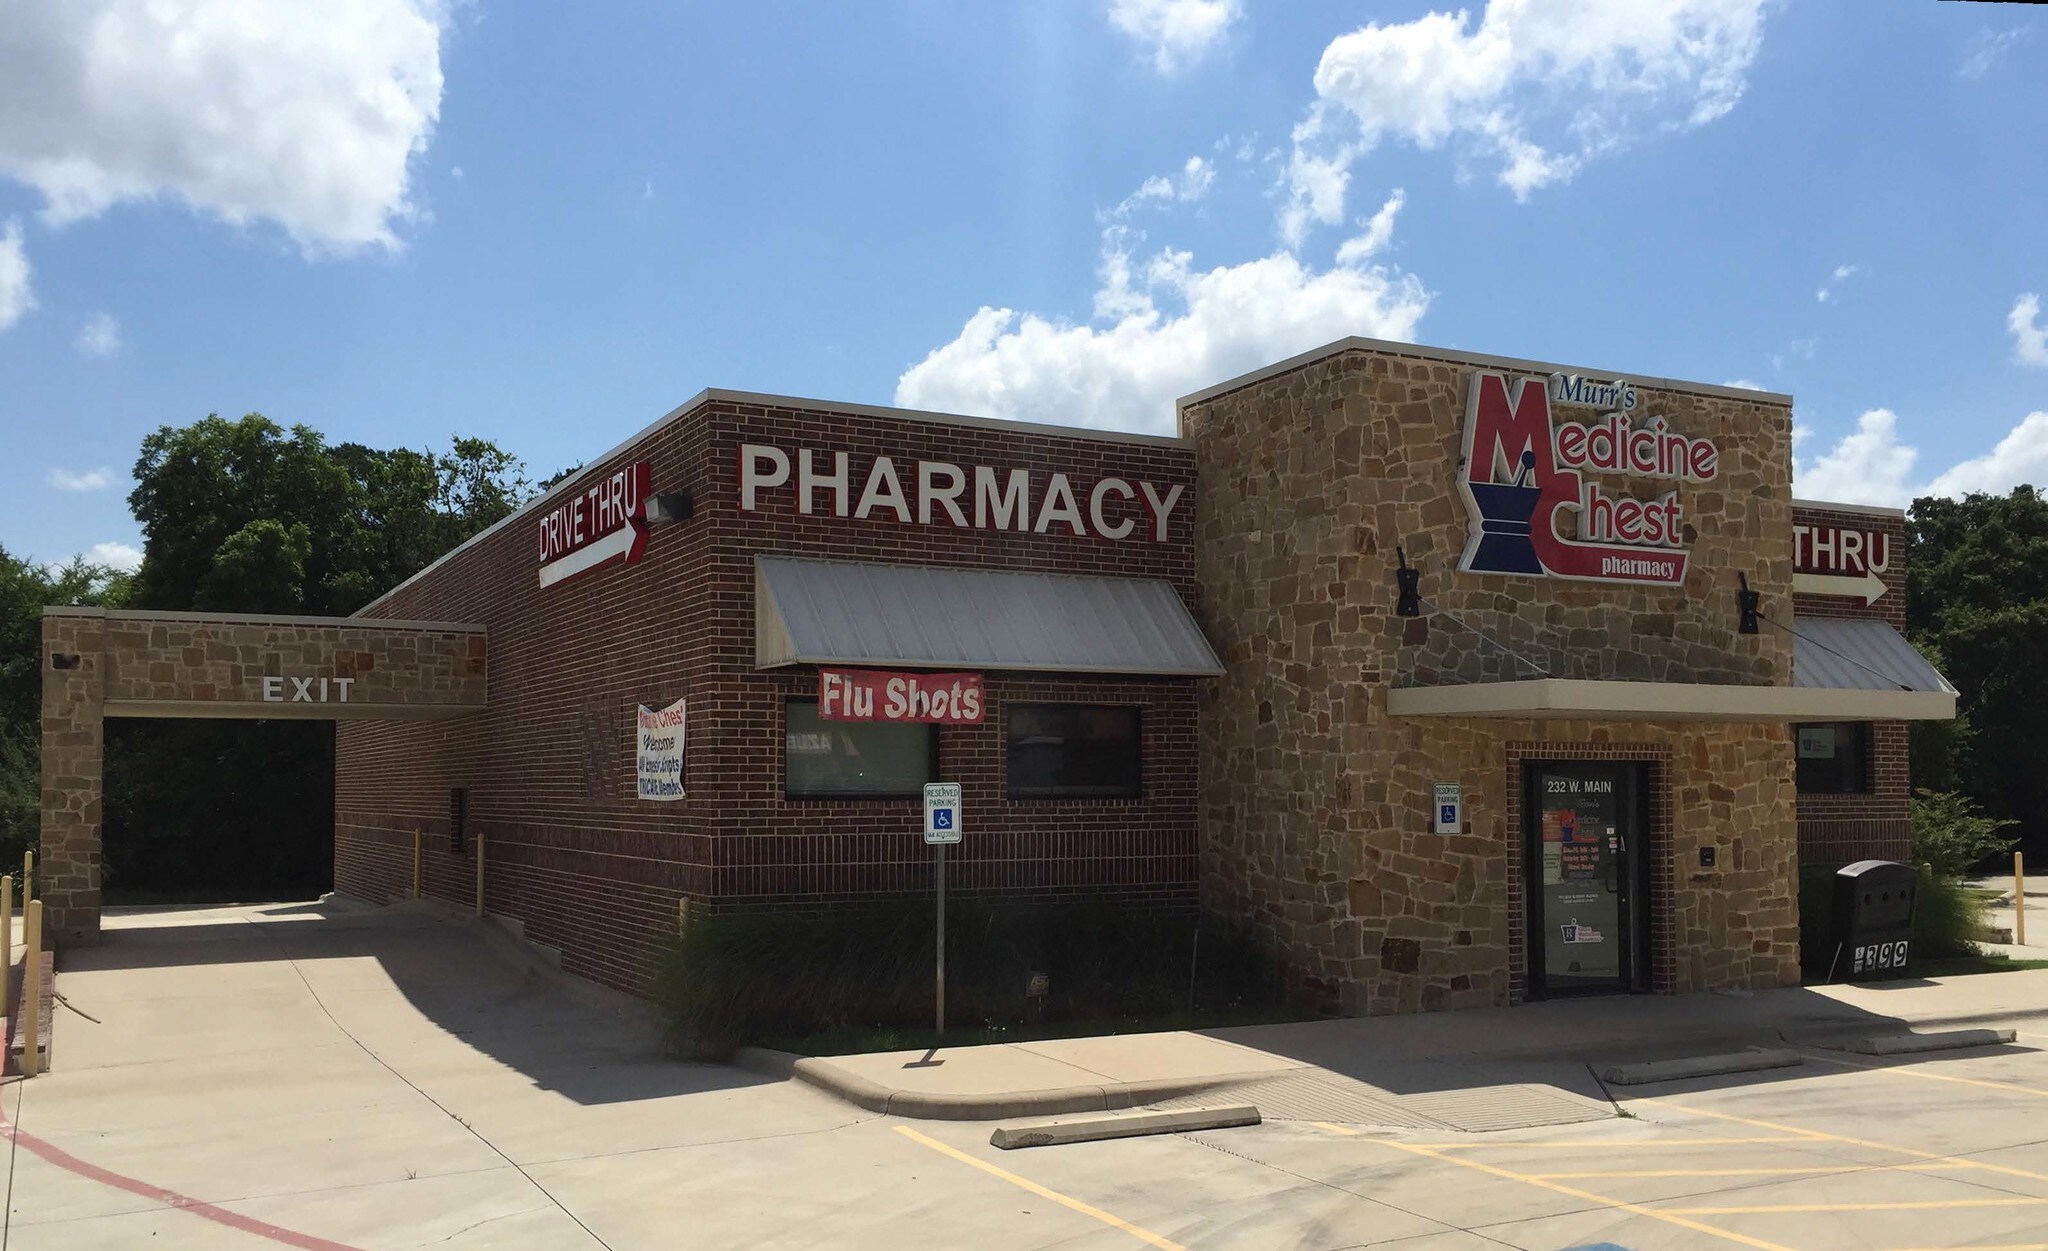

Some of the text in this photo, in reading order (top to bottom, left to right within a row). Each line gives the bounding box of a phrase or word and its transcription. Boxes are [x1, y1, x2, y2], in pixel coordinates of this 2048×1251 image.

[1557, 374, 1636, 408] Murr's
[740, 443, 1185, 542] PHARMACY
[540, 462, 638, 561] DRIVE THRU
[1793, 525, 1890, 573] THRU
[1602, 556, 1676, 579] pharmacy
[263, 676, 355, 702] EXIT
[823, 672, 980, 720] Flu Shots
[927, 788, 958, 798] RESERVED
[1547, 780, 1612, 793] 232 W. MAIN
[929, 798, 956, 807] PARKING
